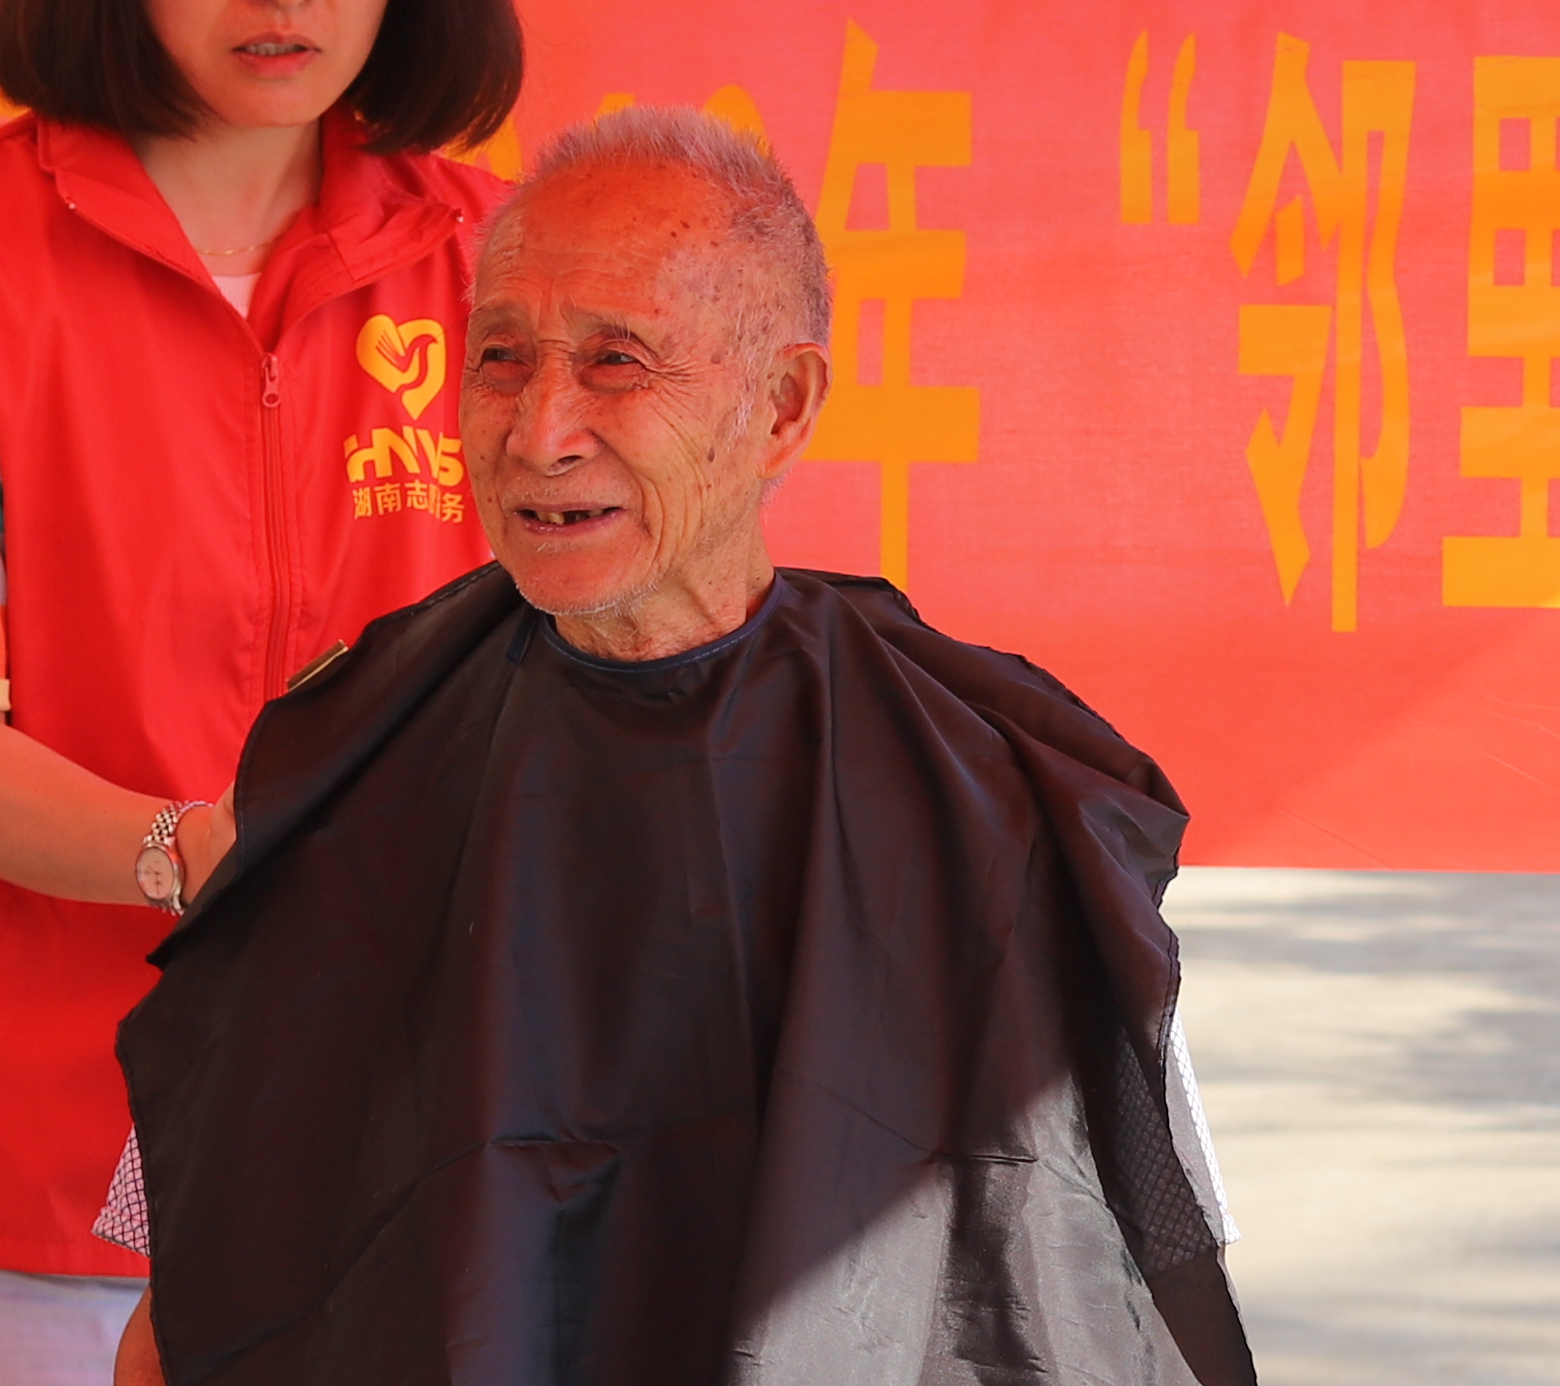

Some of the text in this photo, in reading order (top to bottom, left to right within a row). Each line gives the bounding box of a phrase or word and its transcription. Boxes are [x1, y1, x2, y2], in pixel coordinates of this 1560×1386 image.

[800, 17, 981, 598] 年
[352, 479, 465, 524] 湖南志务
